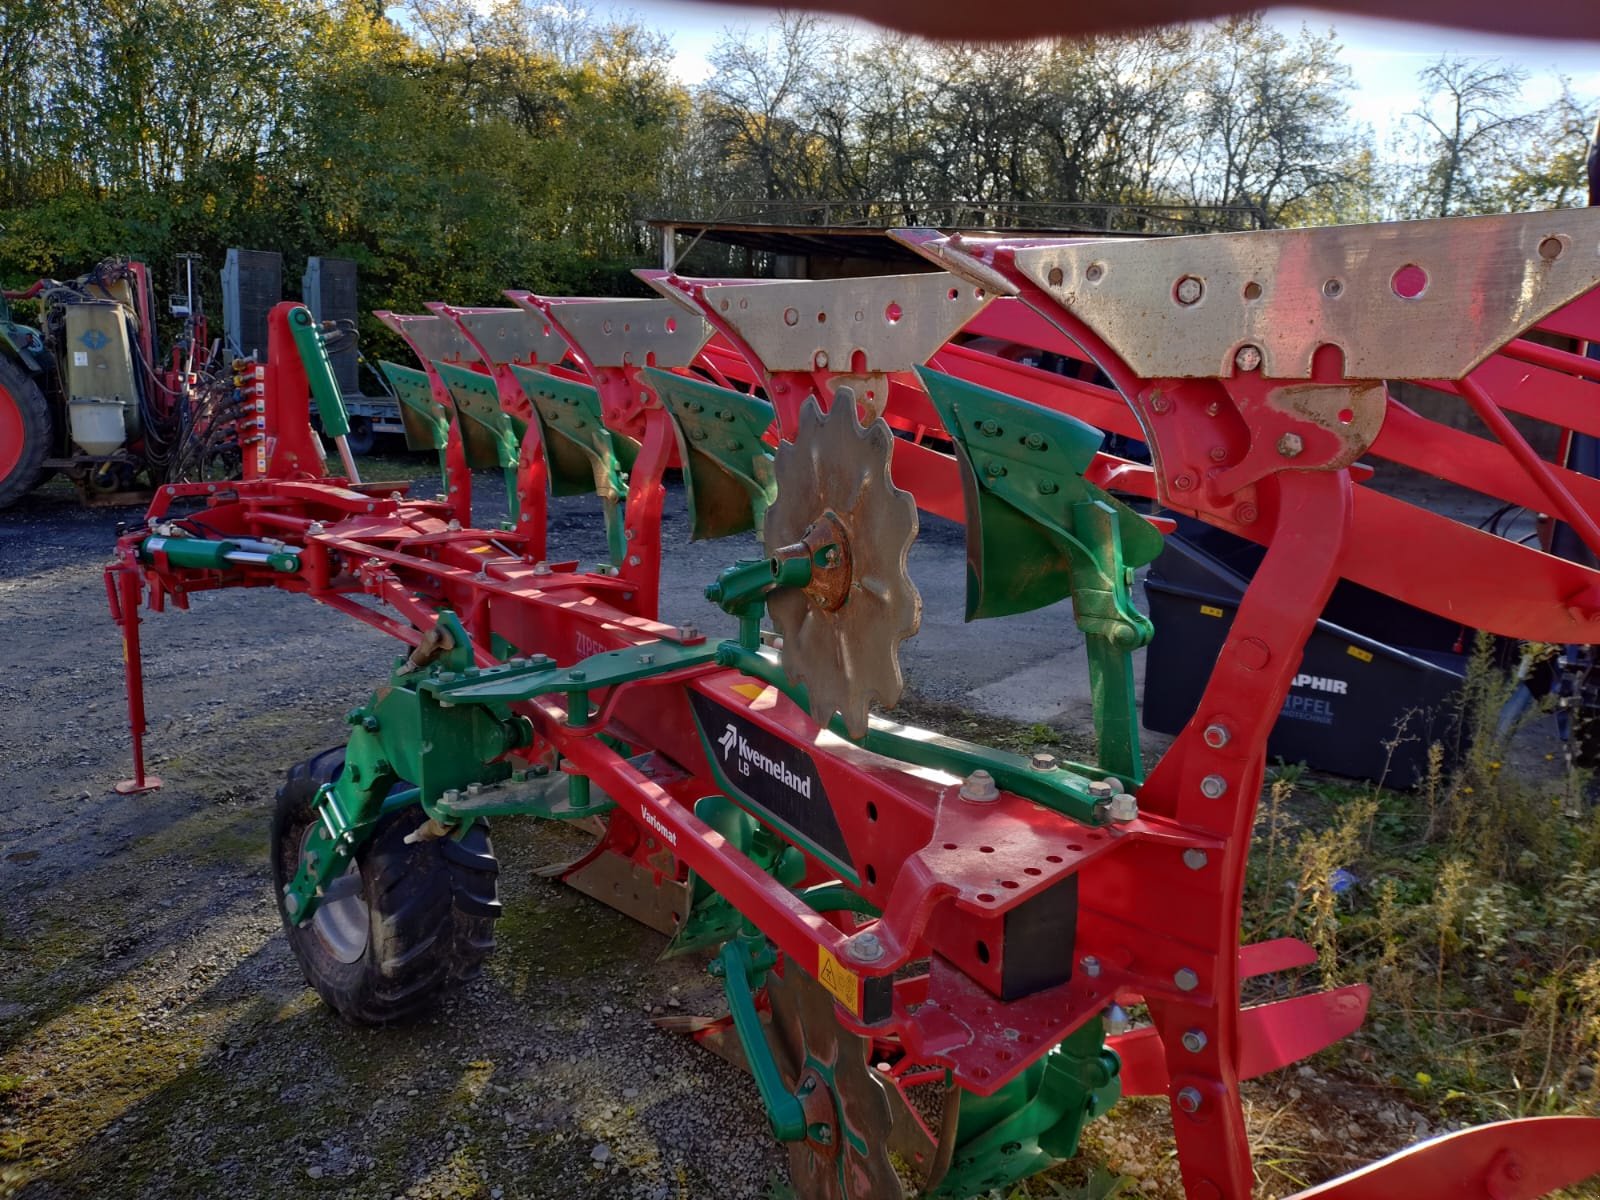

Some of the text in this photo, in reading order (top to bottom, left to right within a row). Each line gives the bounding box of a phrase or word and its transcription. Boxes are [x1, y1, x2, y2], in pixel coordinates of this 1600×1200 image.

[576, 630, 607, 657] ZIPF
[1291, 673, 1348, 695] PHIR
[1284, 694, 1334, 716] IPFEL
[738, 735, 811, 800] Kverneland
[738, 758, 750, 777] LB
[641, 803, 677, 847] Variomat
